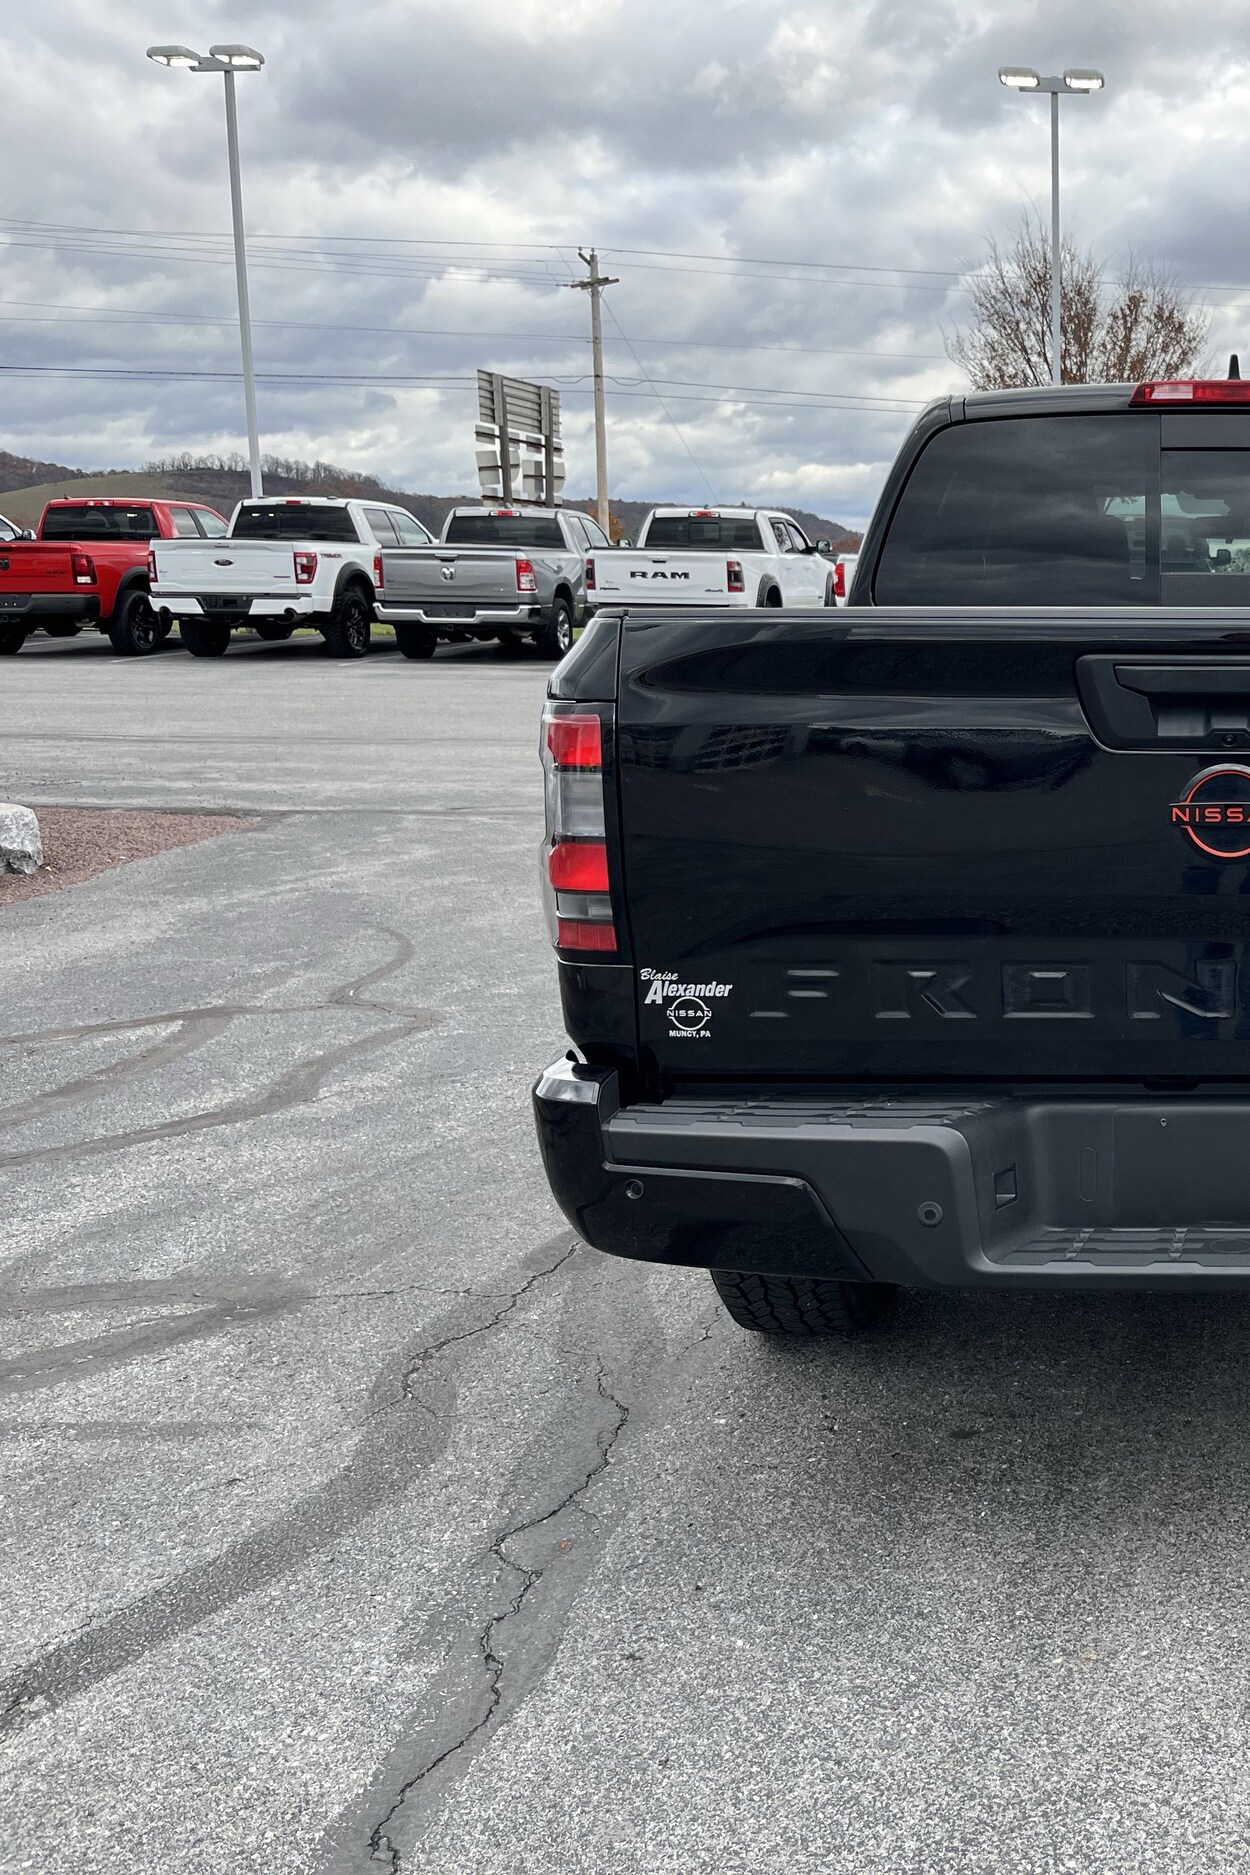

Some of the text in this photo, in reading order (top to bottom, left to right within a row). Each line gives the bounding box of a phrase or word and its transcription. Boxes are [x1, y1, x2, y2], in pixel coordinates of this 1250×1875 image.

[630, 571, 690, 579] RAM
[640, 968, 679, 980] Blaise
[644, 980, 733, 1004] Alexander
[666, 1009, 712, 1017] NISSAN
[669, 1030, 711, 1038] MUNCY, PA
